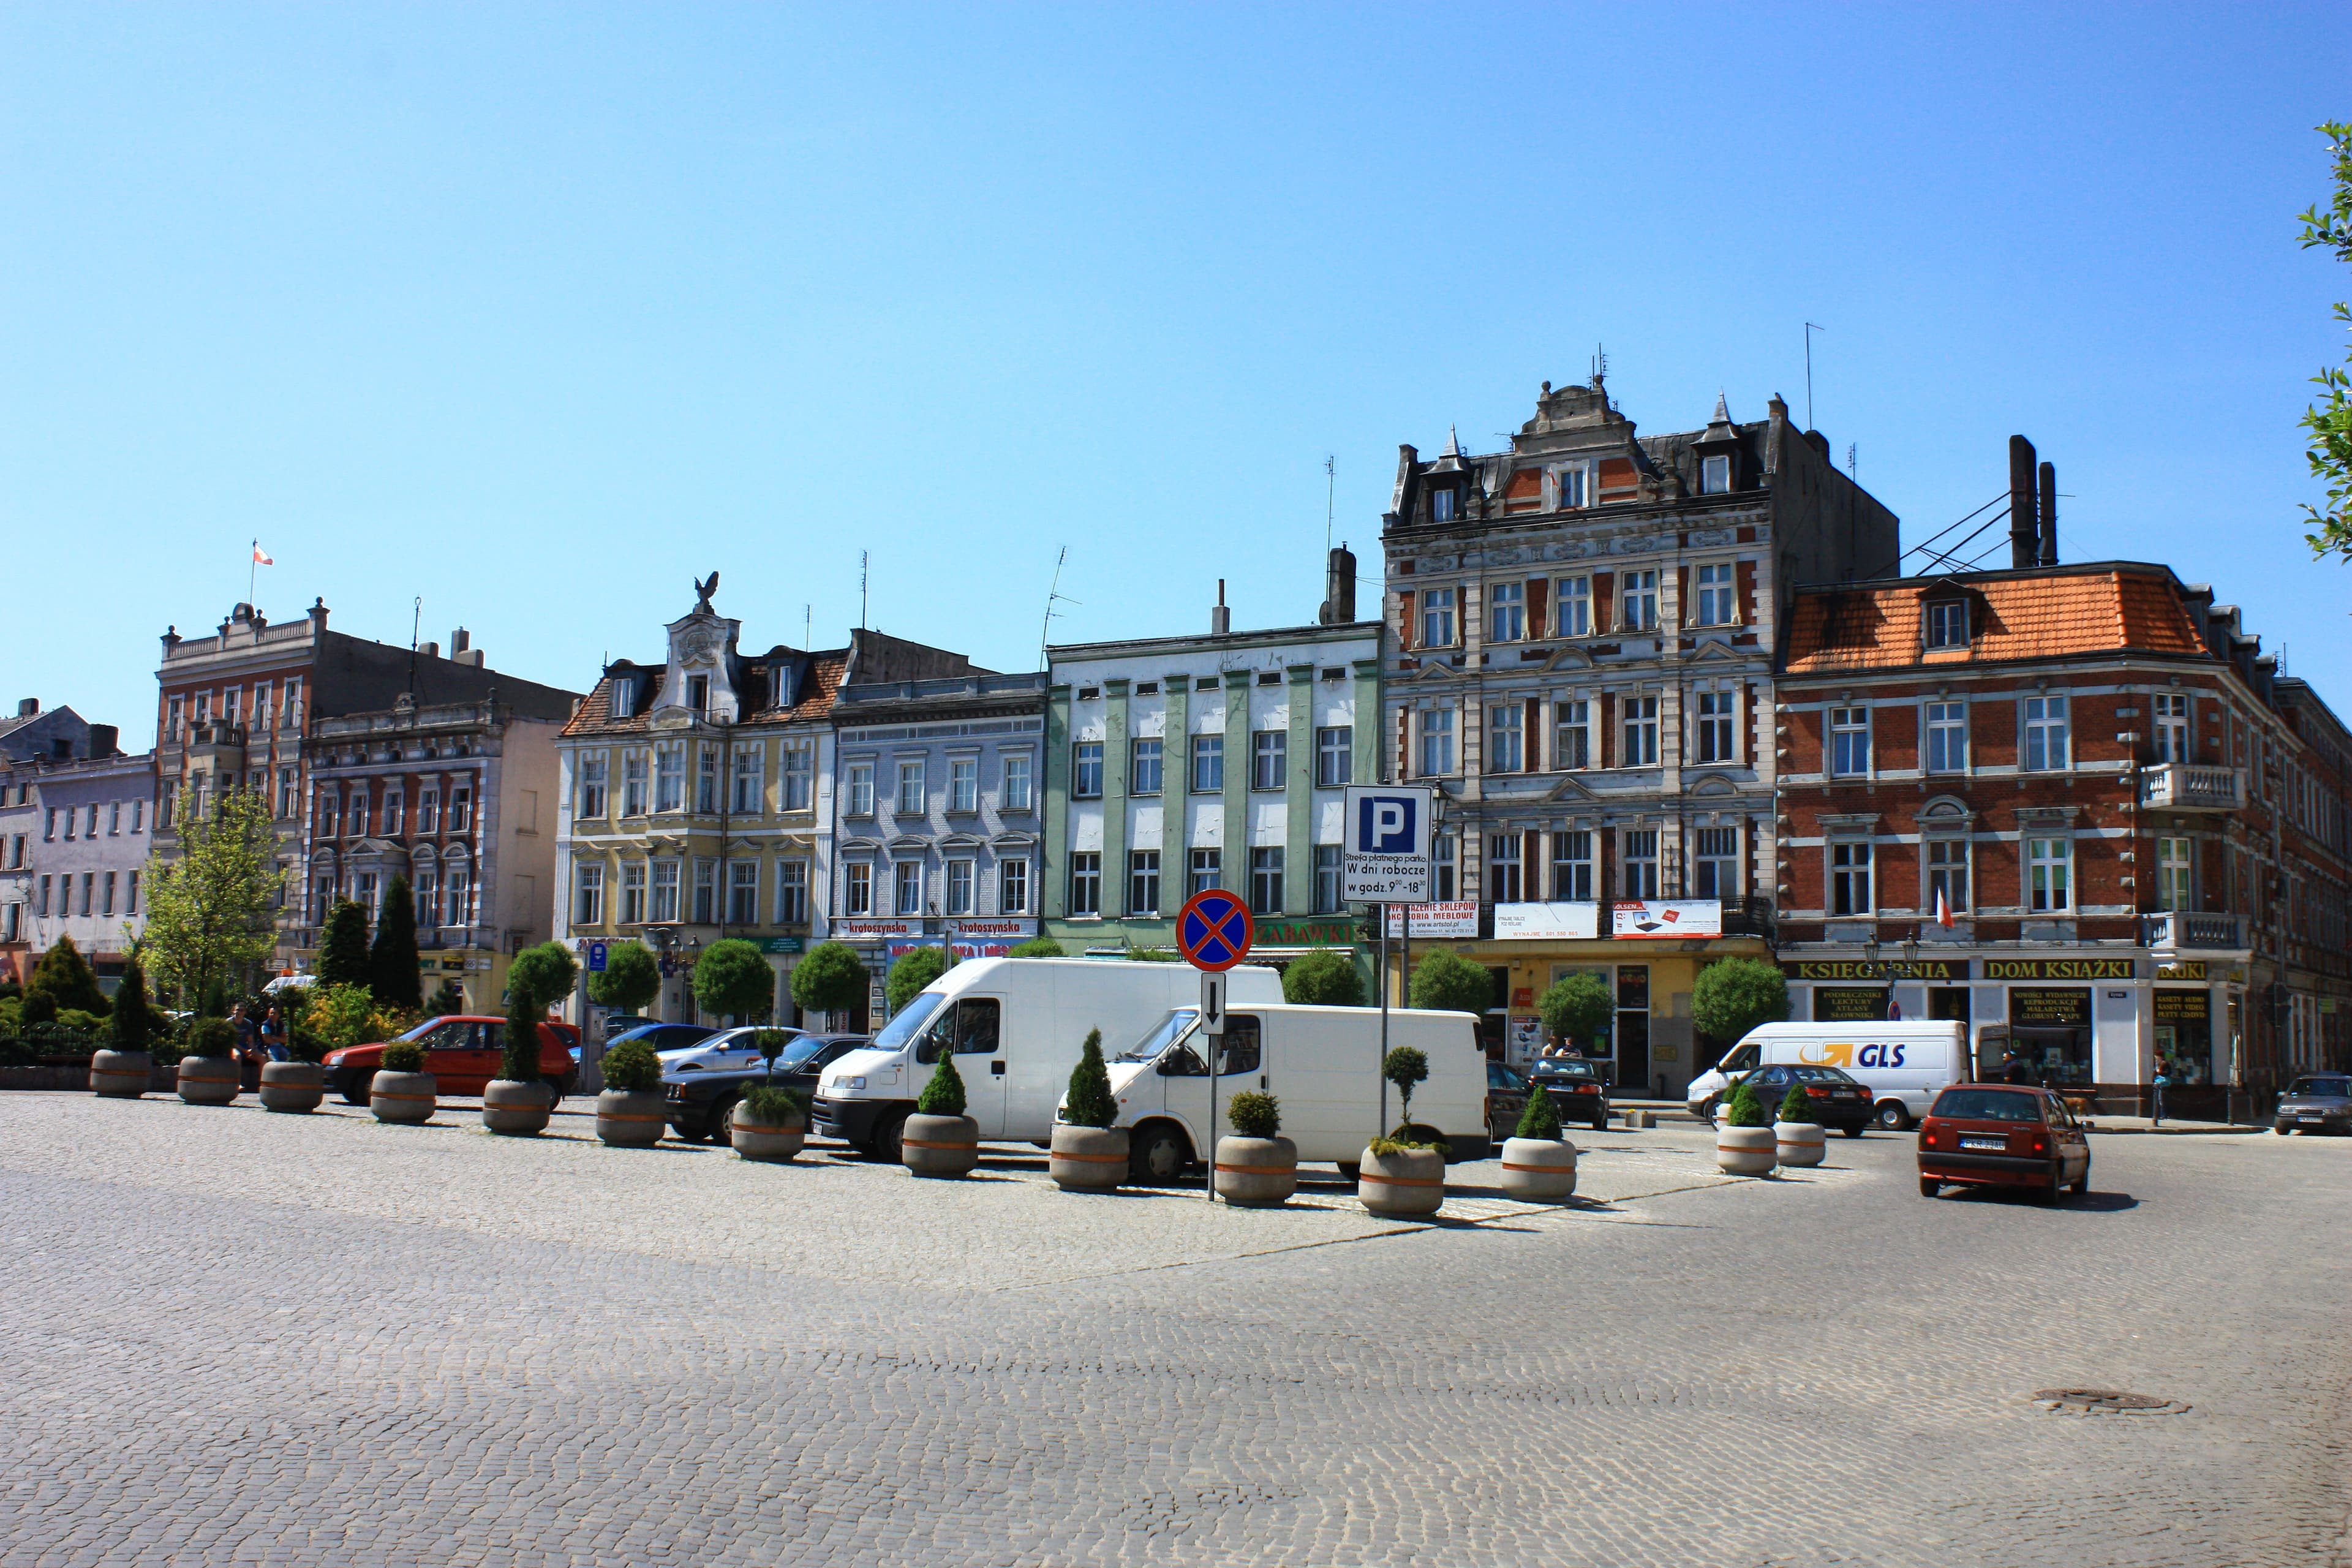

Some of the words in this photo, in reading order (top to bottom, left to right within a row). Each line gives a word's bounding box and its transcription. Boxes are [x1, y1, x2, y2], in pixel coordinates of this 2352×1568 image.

[1372, 802, 1404, 847] P
[1345, 853, 1367, 862] Strefa
[1368, 853, 1403, 864] płatnego
[1404, 854, 1428, 864] parko.
[1347, 863, 1358, 874] W
[1361, 864, 1378, 874] dni
[1382, 864, 1425, 875] robocze
[1359, 881, 1387, 895] godz.
[1257, 924, 1351, 943] ZABAWKI
[1989, 962, 2038, 978] DOM
[2045, 960, 2130, 979] KSIĄŻKI
[1858, 1044, 1905, 1068] GLS
